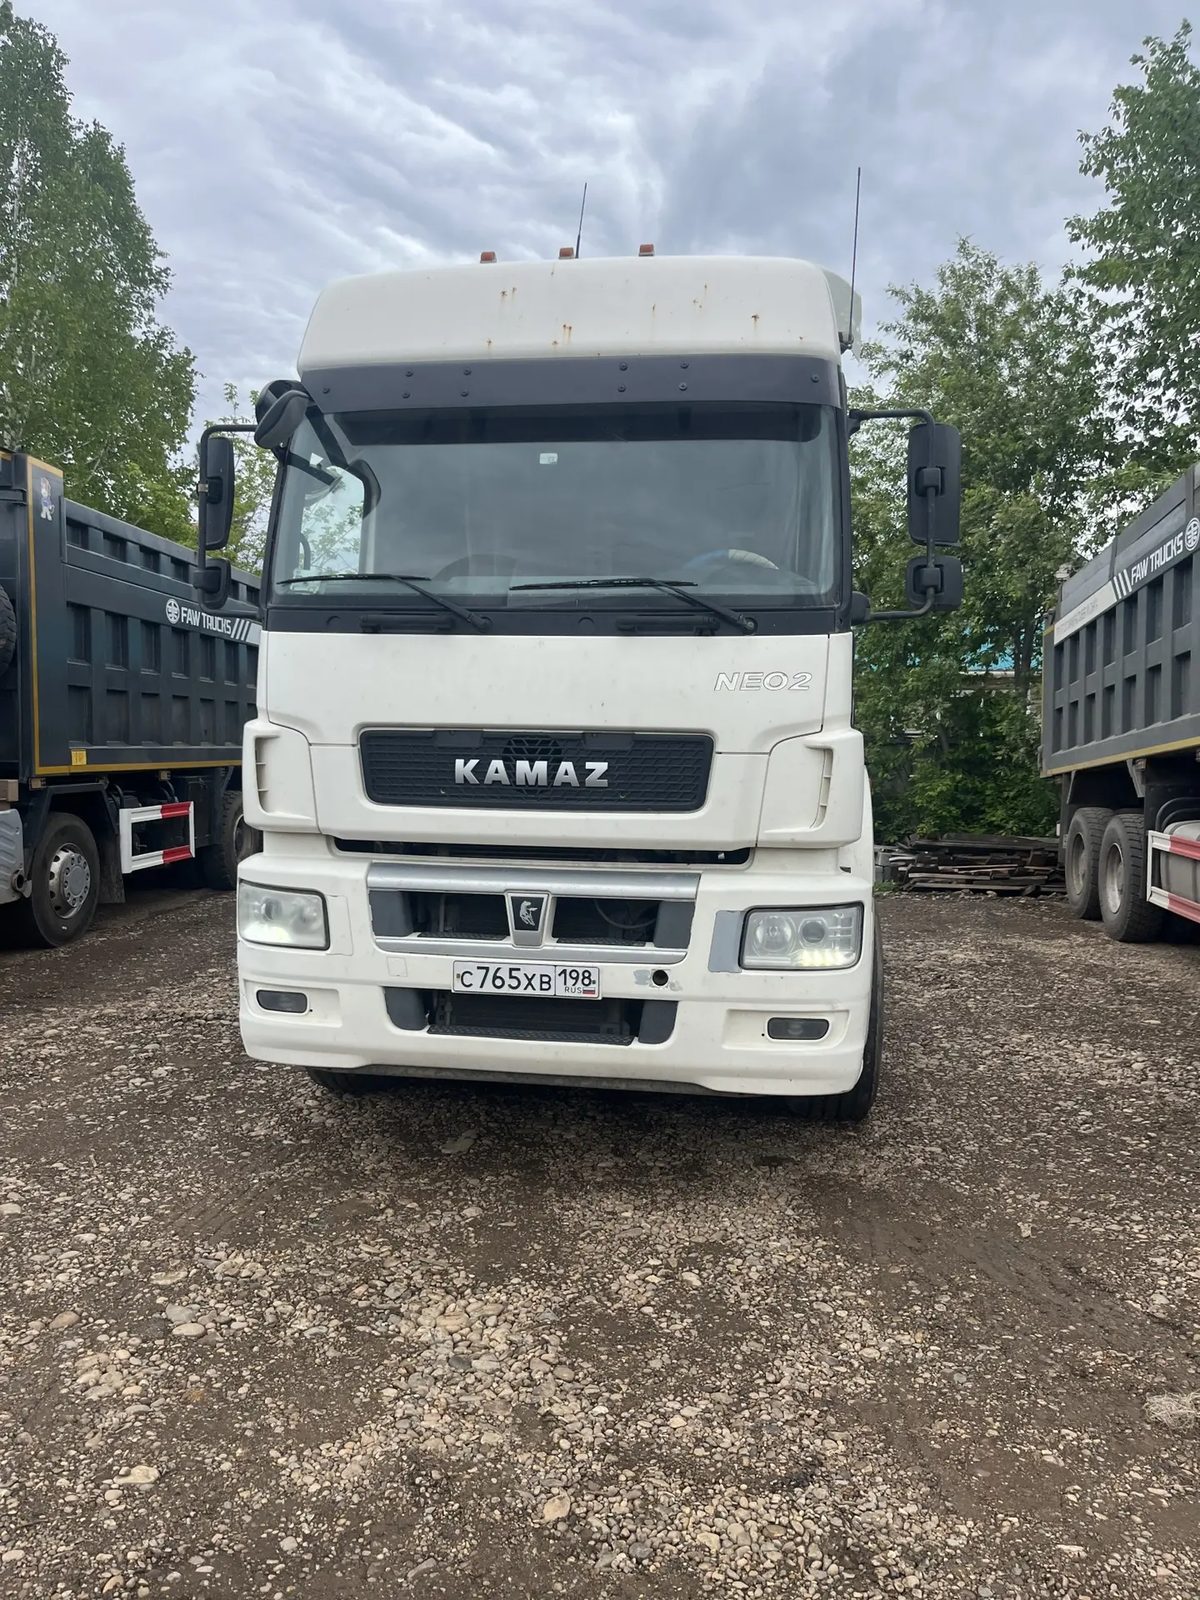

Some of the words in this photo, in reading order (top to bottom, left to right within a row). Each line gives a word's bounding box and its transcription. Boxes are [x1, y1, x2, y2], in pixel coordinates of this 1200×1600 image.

[1131, 557, 1149, 586] FAW
[1150, 531, 1184, 573] TRUCKS
[181, 606, 200, 627] FAW
[201, 612, 232, 635] TRUCKS
[713, 671, 813, 691] NEO2
[454, 758, 609, 787] KAMAZ
[558, 968, 592, 987] 198
[564, 986, 582, 995] RUS
